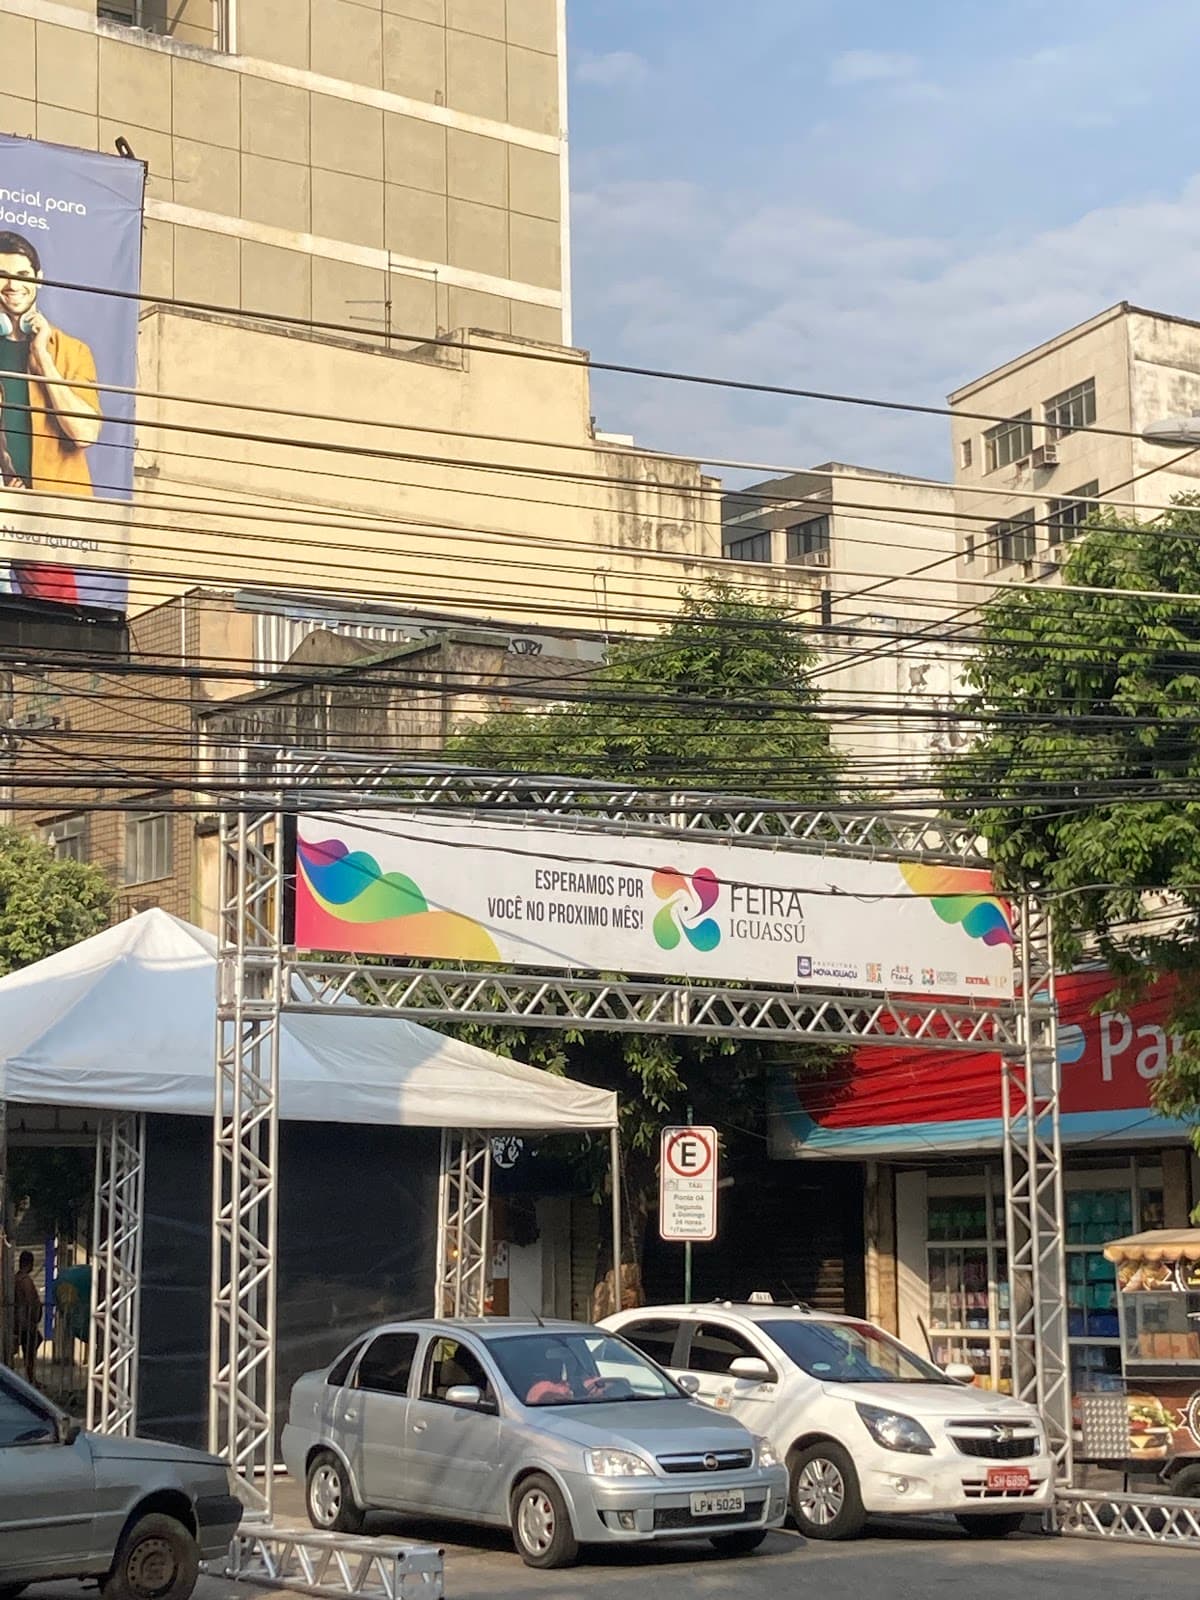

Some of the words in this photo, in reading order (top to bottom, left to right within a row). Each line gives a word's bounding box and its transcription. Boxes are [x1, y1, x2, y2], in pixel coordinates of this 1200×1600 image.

[0, 188, 41, 207] ncial
[45, 198, 87, 216] para
[2, 525, 41, 543] Nova
[535, 869, 614, 896] ESPERAMOS
[618, 877, 644, 899] POR
[488, 895, 522, 920] VOCÊ
[526, 901, 544, 922] NO
[549, 902, 608, 927] PROXIMO
[612, 905, 644, 930] MÊS!
[731, 884, 804, 919] FEIRA
[729, 918, 805, 943] IGUASSÚ
[681, 1142, 696, 1167] E
